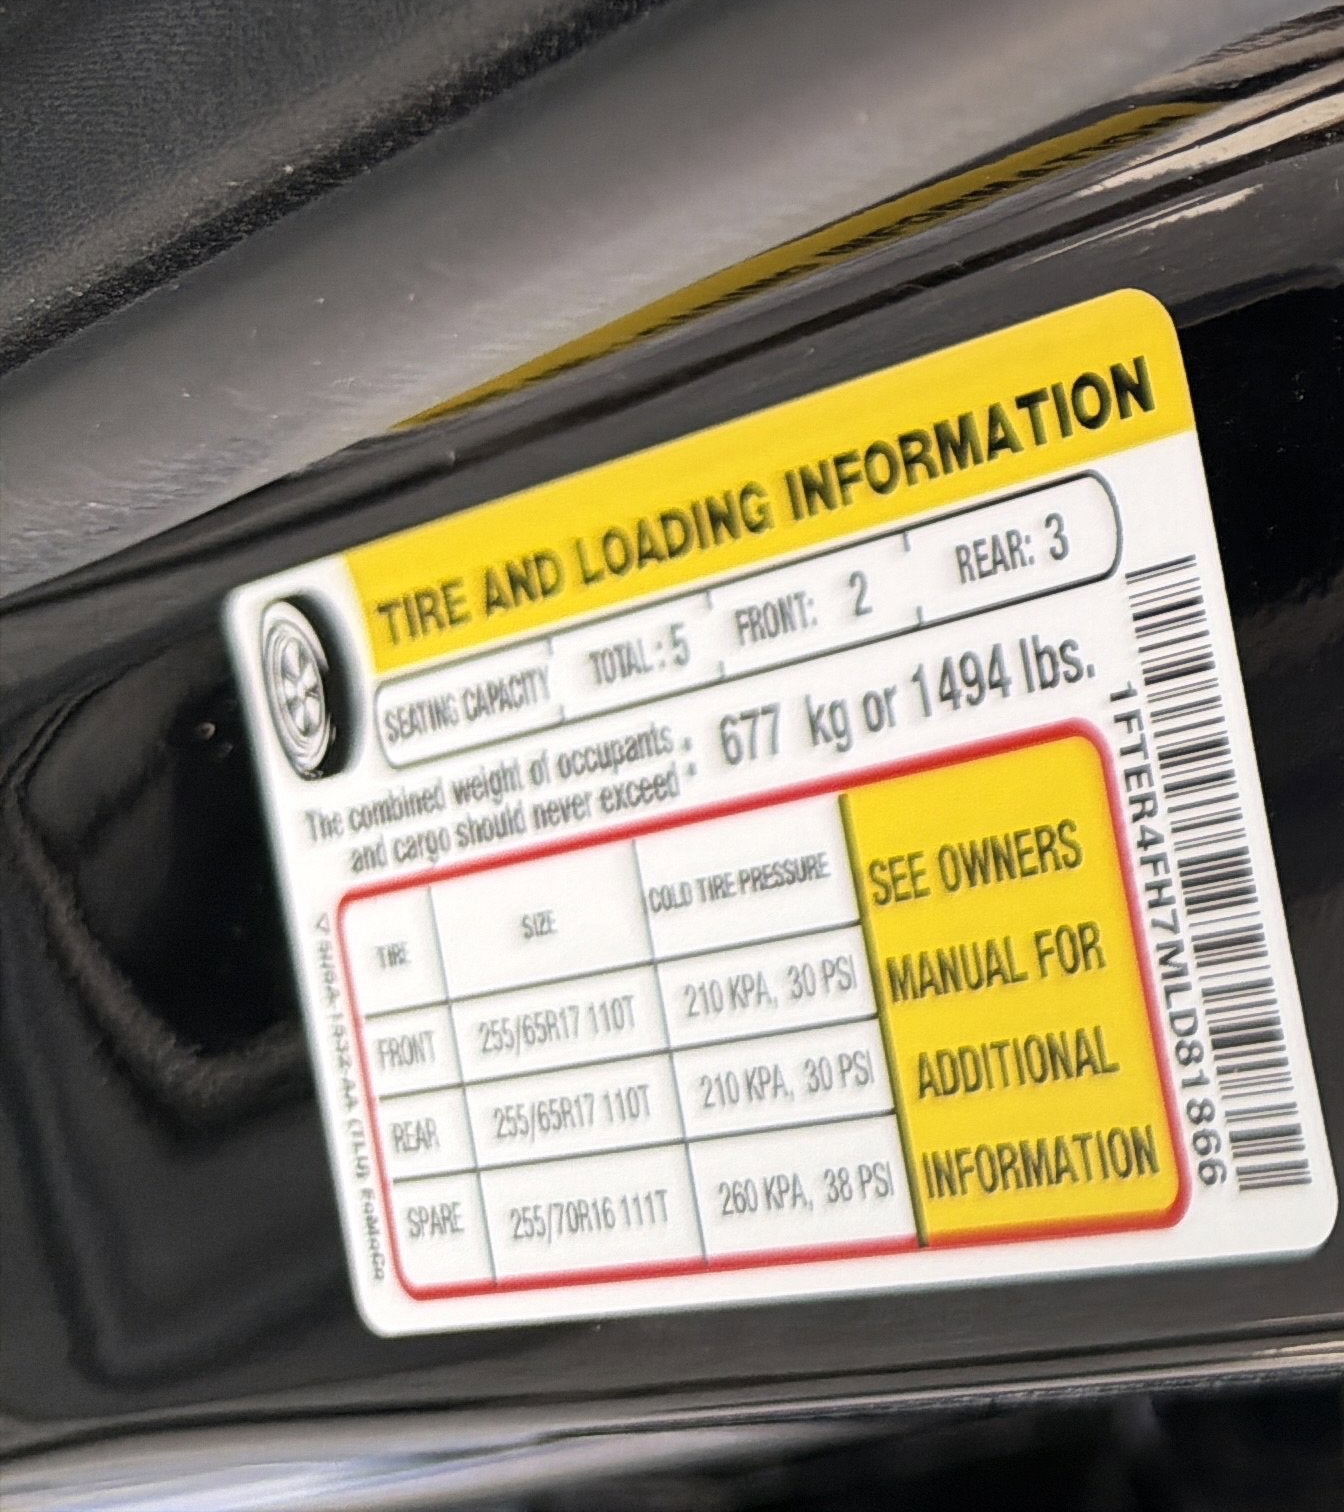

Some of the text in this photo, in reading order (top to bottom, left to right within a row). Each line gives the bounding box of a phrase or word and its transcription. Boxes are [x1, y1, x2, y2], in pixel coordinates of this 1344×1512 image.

[480, 548, 565, 618] AND
[572, 480, 775, 588] LOADING
[781, 353, 1158, 522] INFORMATION
[951, 510, 1072, 586] REAR: 3
[664, 620, 693, 669] 5
[730, 568, 876, 648] FRONT: 2
[380, 666, 550, 746] SEATING CAPACITY
[714, 632, 1098, 768] 677 kg or 1494 lbs.
[301, 722, 677, 844] The combined weight occupants
[346, 760, 683, 876] and cargo should never exceed
[644, 879, 697, 916] COLD
[733, 850, 833, 896] PRESSURE
[864, 816, 1086, 908] SEE OWNERS
[882, 919, 1109, 1005] MANUAL FOR
[1106, 680, 1231, 1188] 1FTER4FH7MLD81866
[679, 952, 861, 1021] 210 30 PSI
[372, 1027, 439, 1072] FRONT
[474, 1002, 583, 1056] 255/65R17
[914, 1023, 1124, 1101] ADDITIONAL
[488, 1090, 598, 1143] 255/65R17
[695, 1048, 878, 1112] 210 30 PSI
[387, 1115, 443, 1156] REAR
[918, 1122, 1163, 1200] INFORMATION
[402, 1198, 468, 1241] SPARE
[506, 1194, 620, 1244] 255/70R16
[714, 1176, 762, 1218] 260
[819, 1164, 857, 1206] 38
[853, 1159, 898, 1201] PSI
